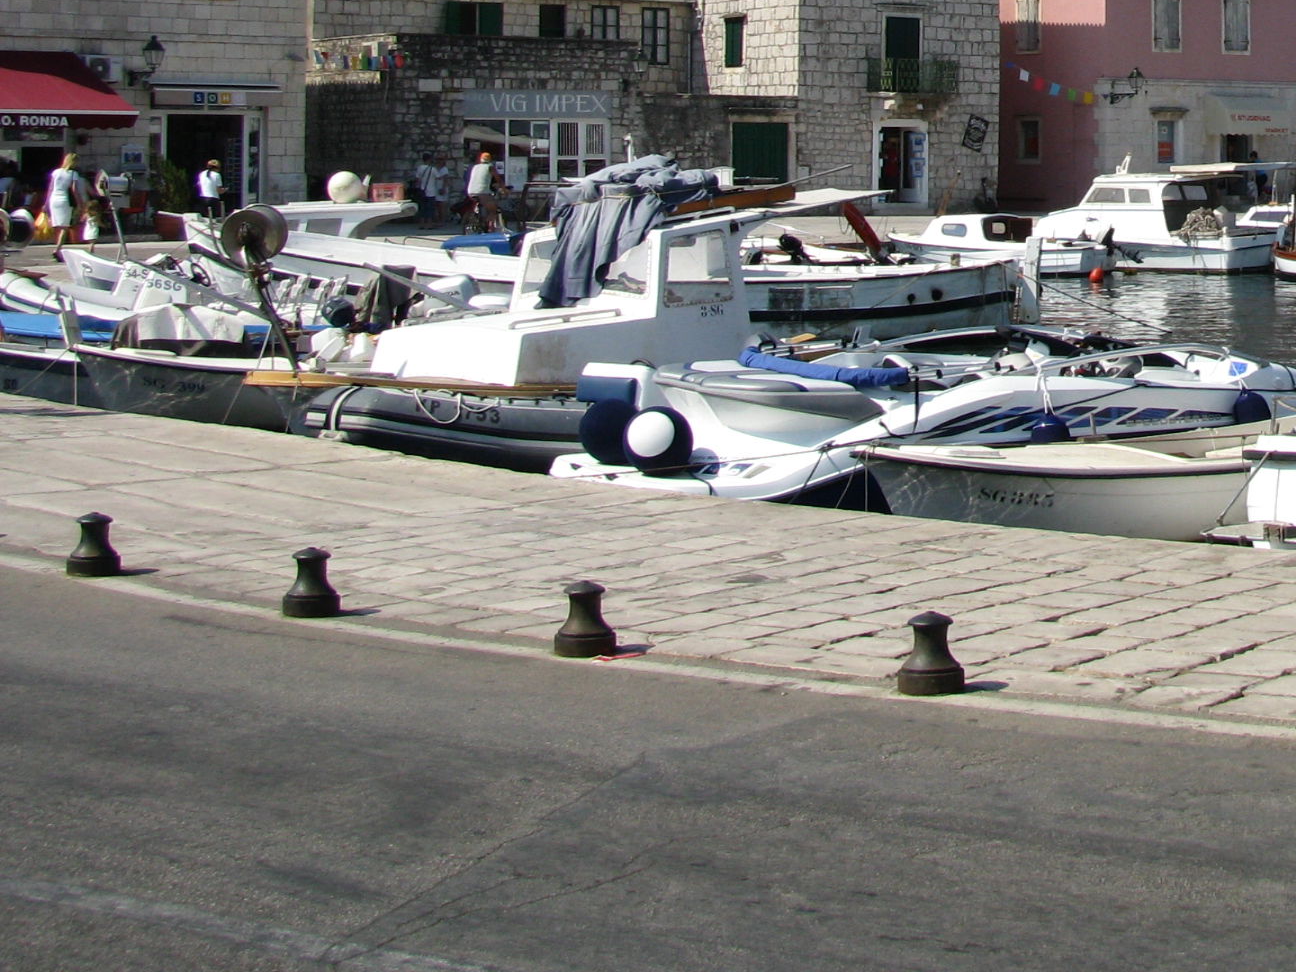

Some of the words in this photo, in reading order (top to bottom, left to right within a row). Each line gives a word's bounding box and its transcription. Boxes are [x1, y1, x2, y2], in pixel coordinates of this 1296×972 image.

[490, 94, 527, 112] VIG
[536, 94, 607, 113] IMPEX
[20, 115, 69, 126] RONDA
